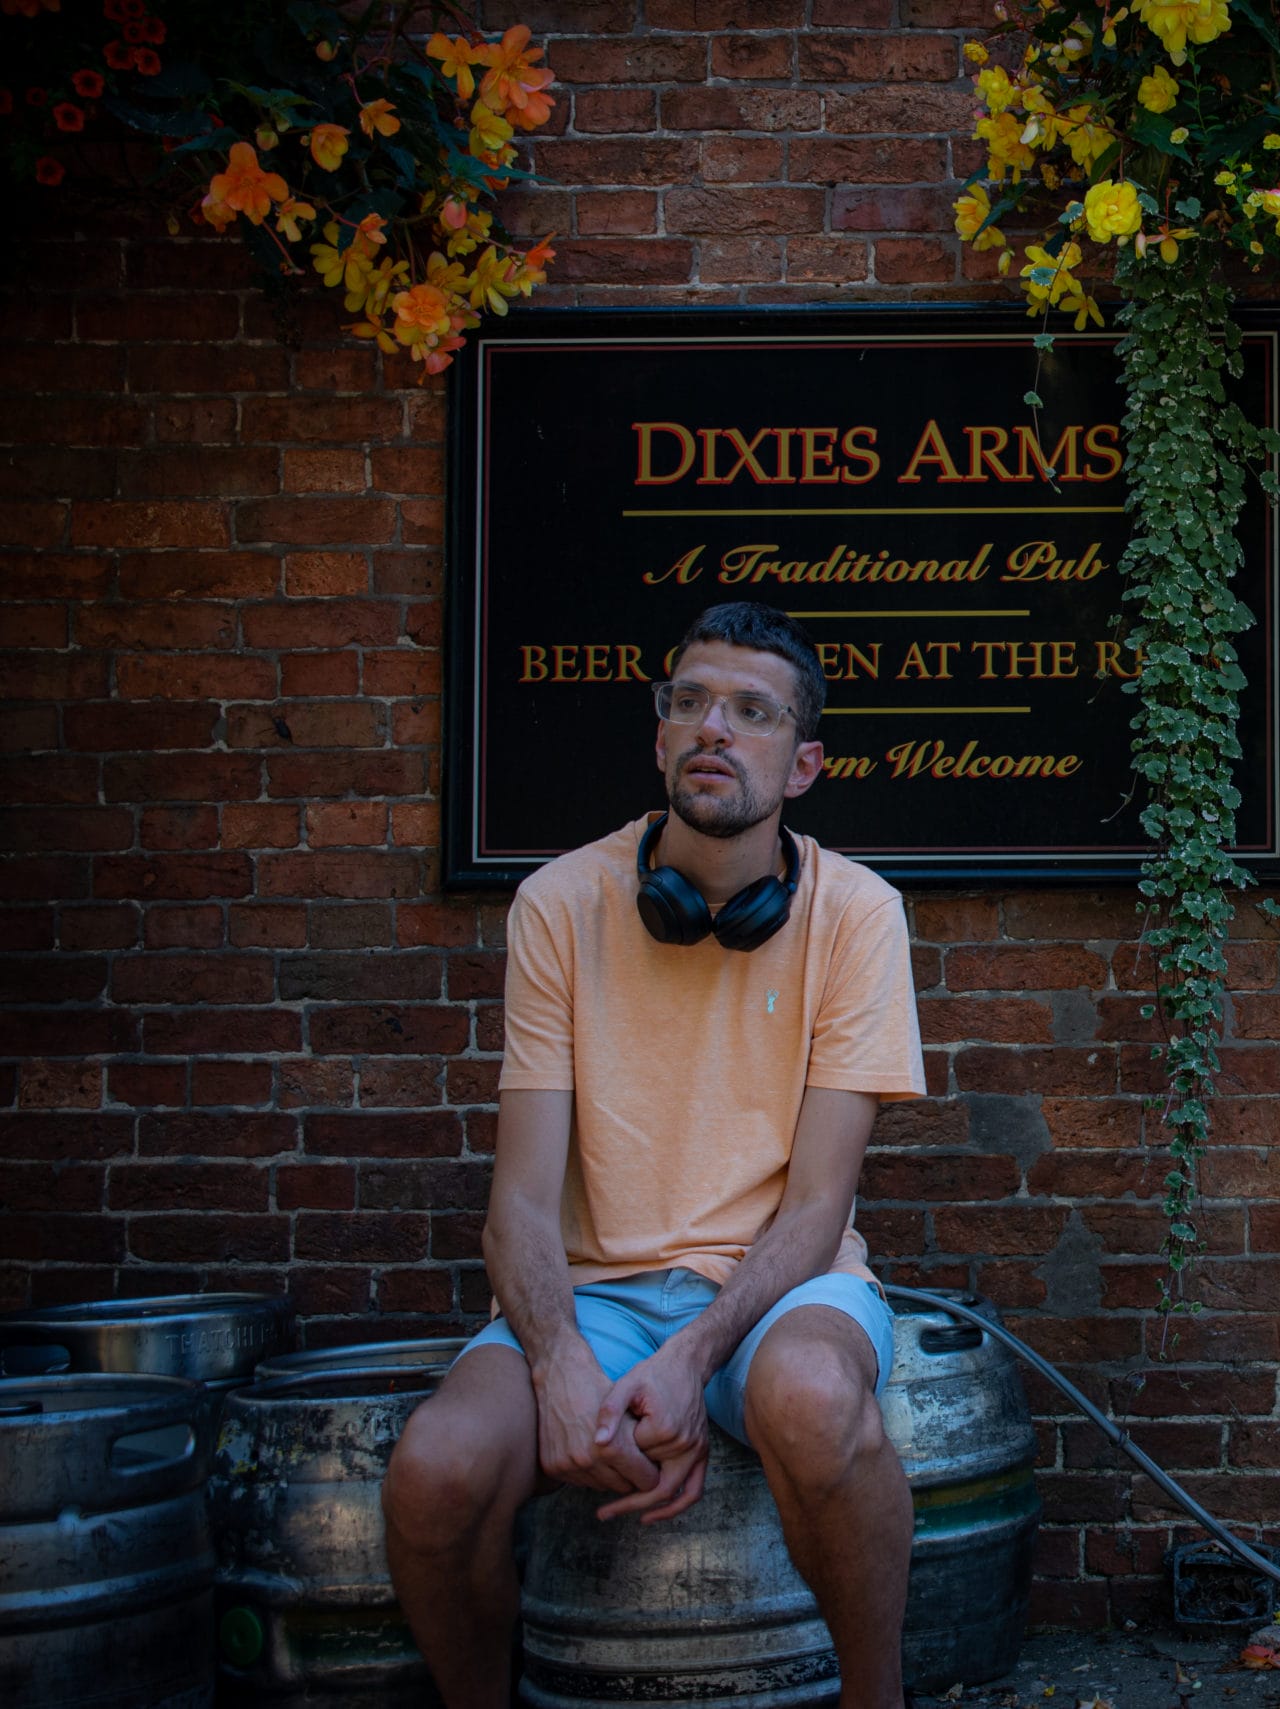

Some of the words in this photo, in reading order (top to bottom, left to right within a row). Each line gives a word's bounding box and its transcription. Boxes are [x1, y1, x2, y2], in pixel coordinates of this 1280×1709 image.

[631, 421, 881, 486] DIXIES
[897, 419, 1123, 484] ARMS
[643, 546, 703, 586] A
[717, 543, 993, 586] Traditional
[1000, 540, 1111, 583] Pub
[519, 645, 652, 684] BEER
[896, 642, 960, 681] AT
[970, 641, 1079, 680] THE
[822, 756, 878, 781] rm
[885, 740, 1083, 781] Welcome
